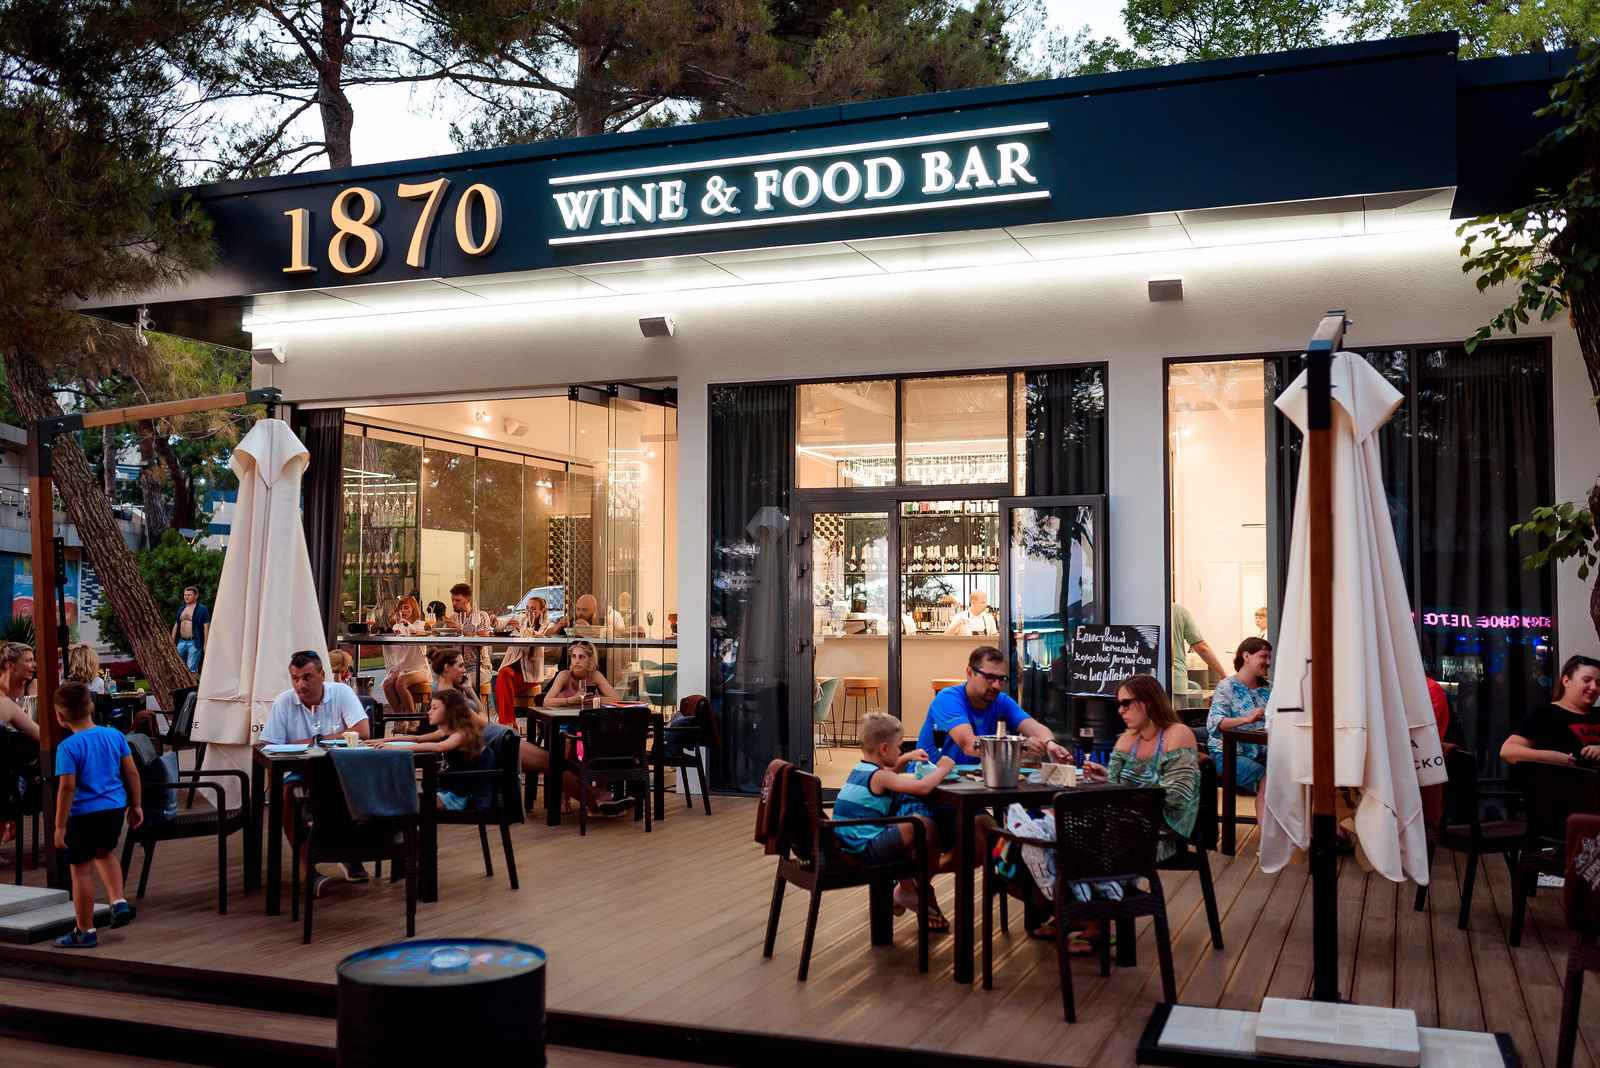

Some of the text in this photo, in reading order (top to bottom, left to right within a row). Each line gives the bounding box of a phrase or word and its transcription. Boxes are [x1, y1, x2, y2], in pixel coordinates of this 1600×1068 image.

[282, 177, 503, 275] 1870
[552, 142, 1039, 231] WINE & FOOD BAR
